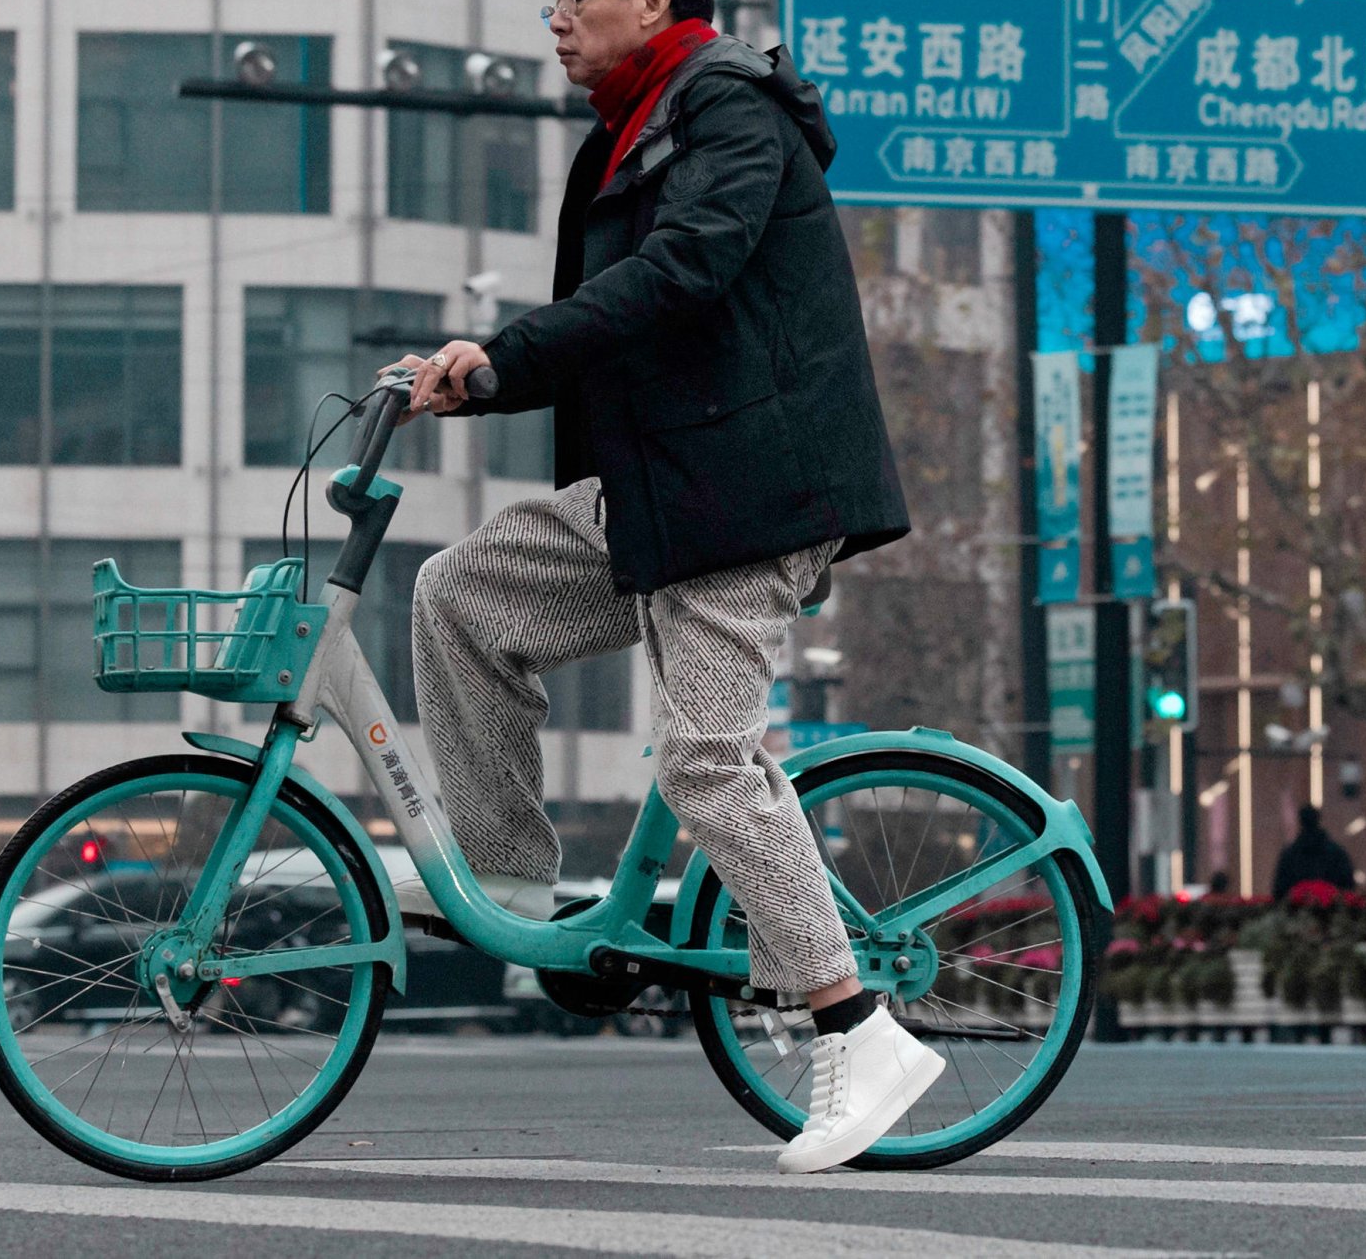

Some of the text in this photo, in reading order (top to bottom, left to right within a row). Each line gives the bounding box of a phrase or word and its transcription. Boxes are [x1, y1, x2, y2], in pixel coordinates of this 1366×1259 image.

[799, 16, 1027, 83] 延安西路
[1198, 93, 1330, 140] Chengdu
[902, 136, 1058, 178] 南京西路
[1125, 143, 1280, 188] 南京西路
[380, 748, 425, 819] 滴滴青桔
